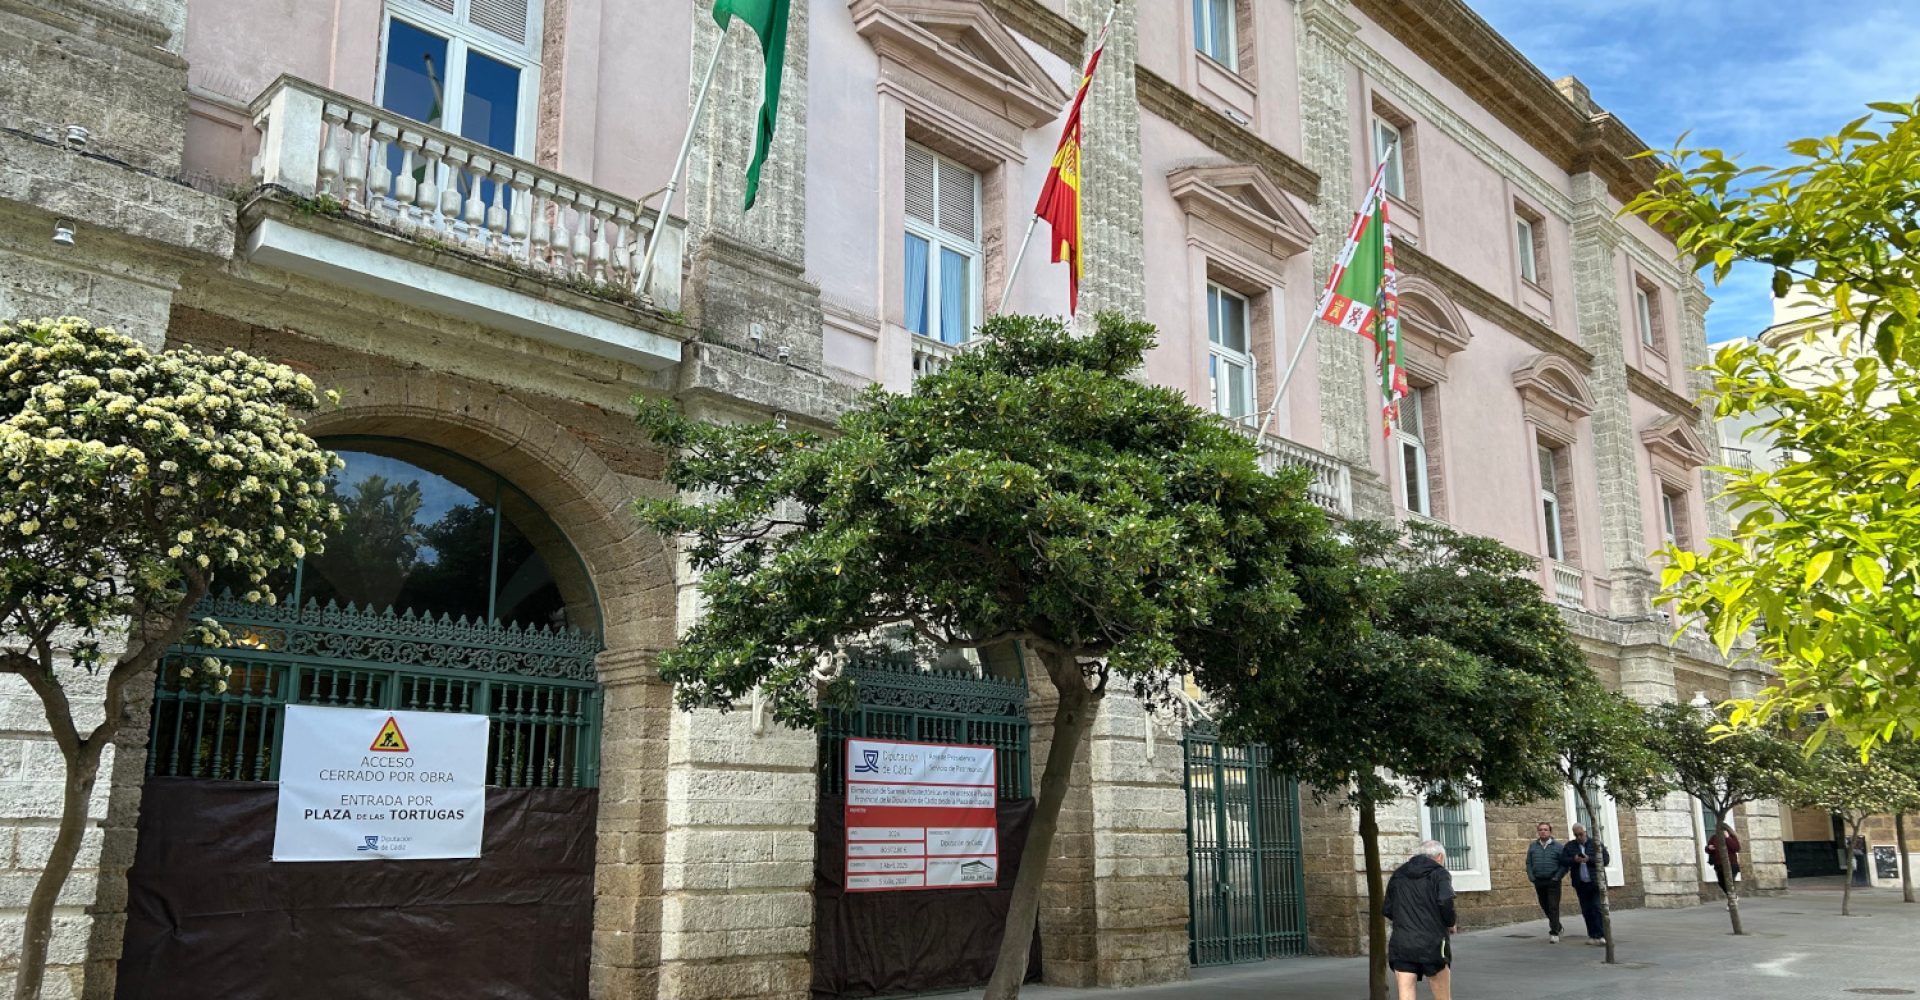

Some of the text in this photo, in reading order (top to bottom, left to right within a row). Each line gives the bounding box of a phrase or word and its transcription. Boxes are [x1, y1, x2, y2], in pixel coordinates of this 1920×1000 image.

[882, 750, 919, 762] Diputación
[361, 756, 414, 768] ACCESO
[882, 764, 891, 774] de
[319, 769, 454, 783] CERRADO POR OBRA
[341, 795, 433, 806] ENTRADA POR
[304, 809, 352, 820] PLAZA
[390, 809, 464, 820] TORTUGAS
